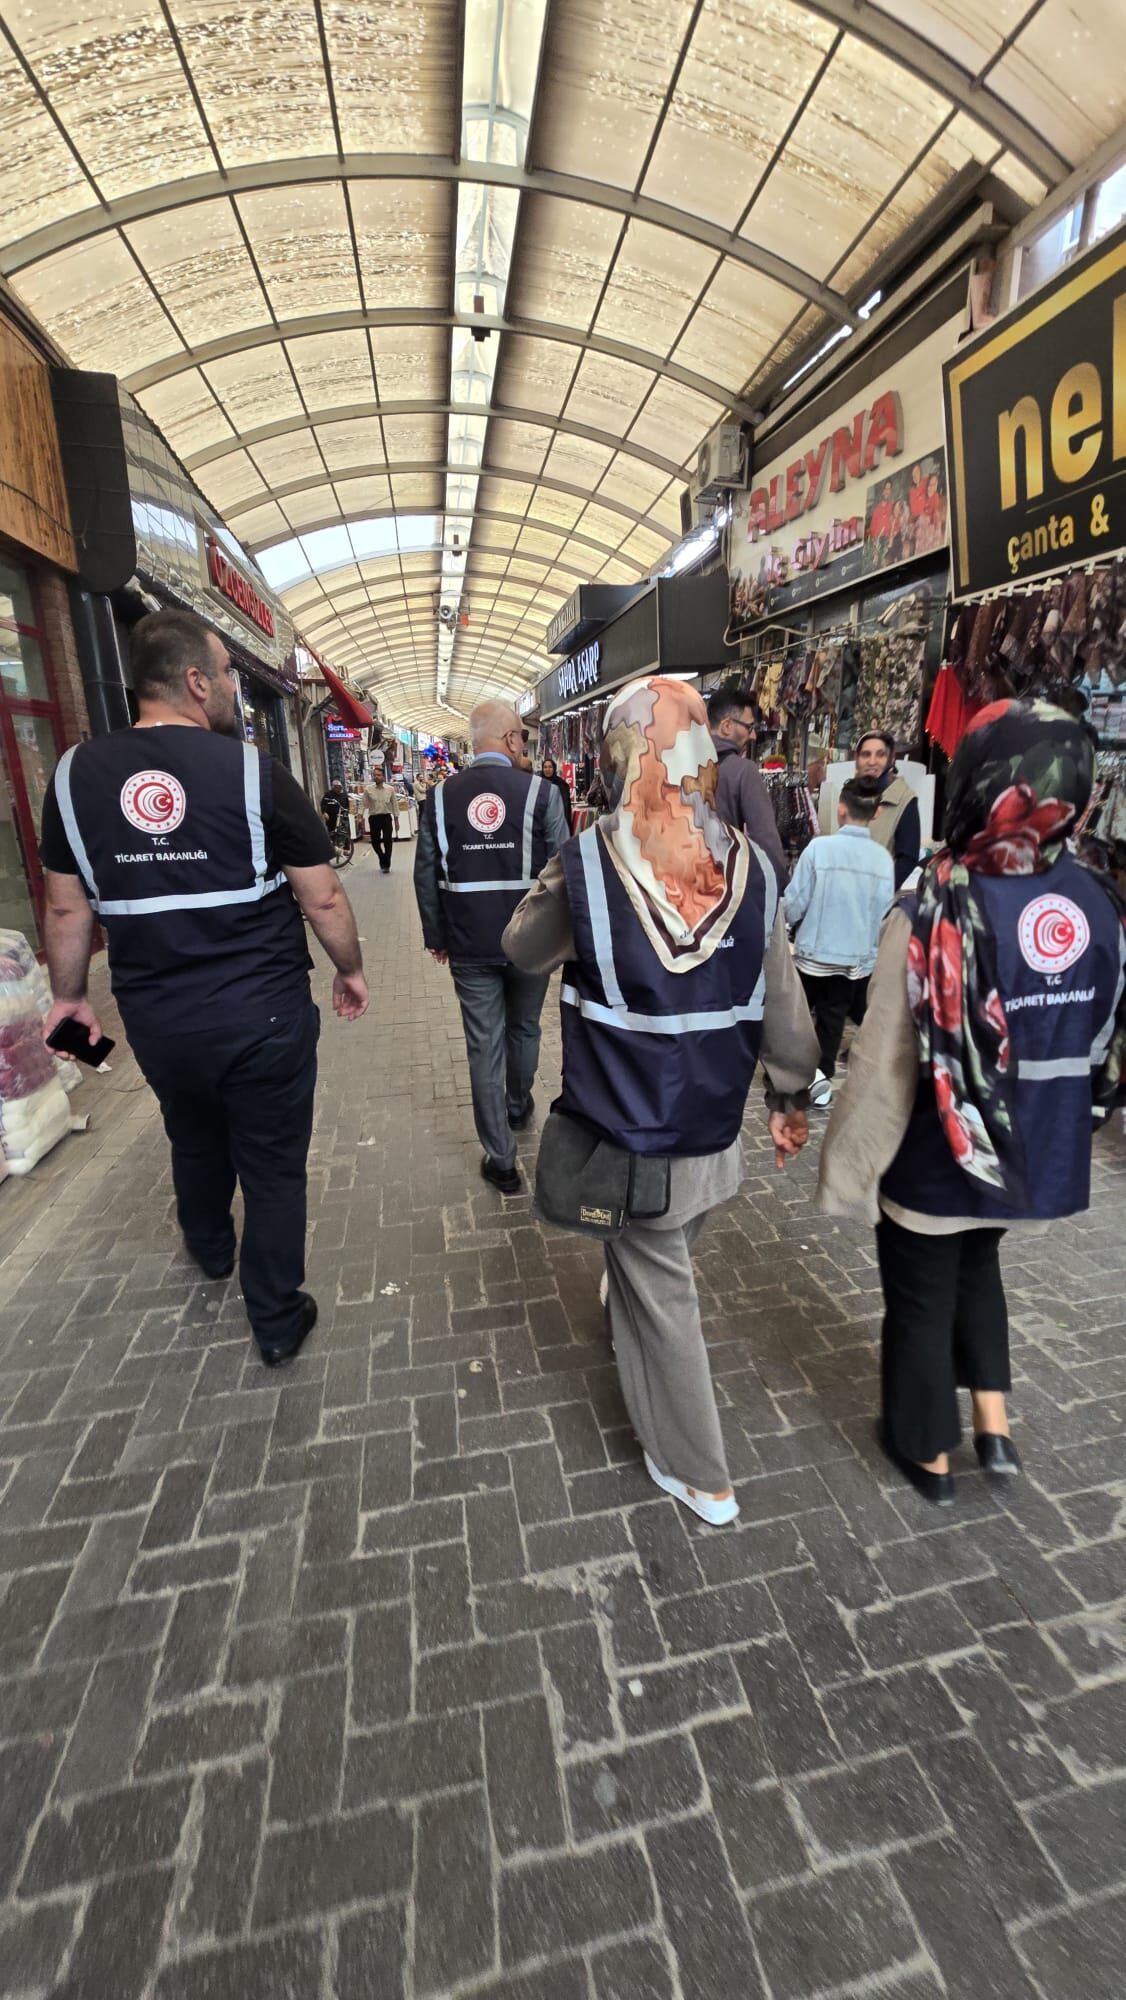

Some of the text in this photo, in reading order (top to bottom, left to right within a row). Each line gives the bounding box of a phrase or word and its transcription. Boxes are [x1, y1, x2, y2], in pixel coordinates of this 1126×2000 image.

[747, 390, 903, 542] ALEYNA
[1007, 493, 1110, 575] çanta &
[114, 850, 207, 863] TİCARET BAKANLIĞI
